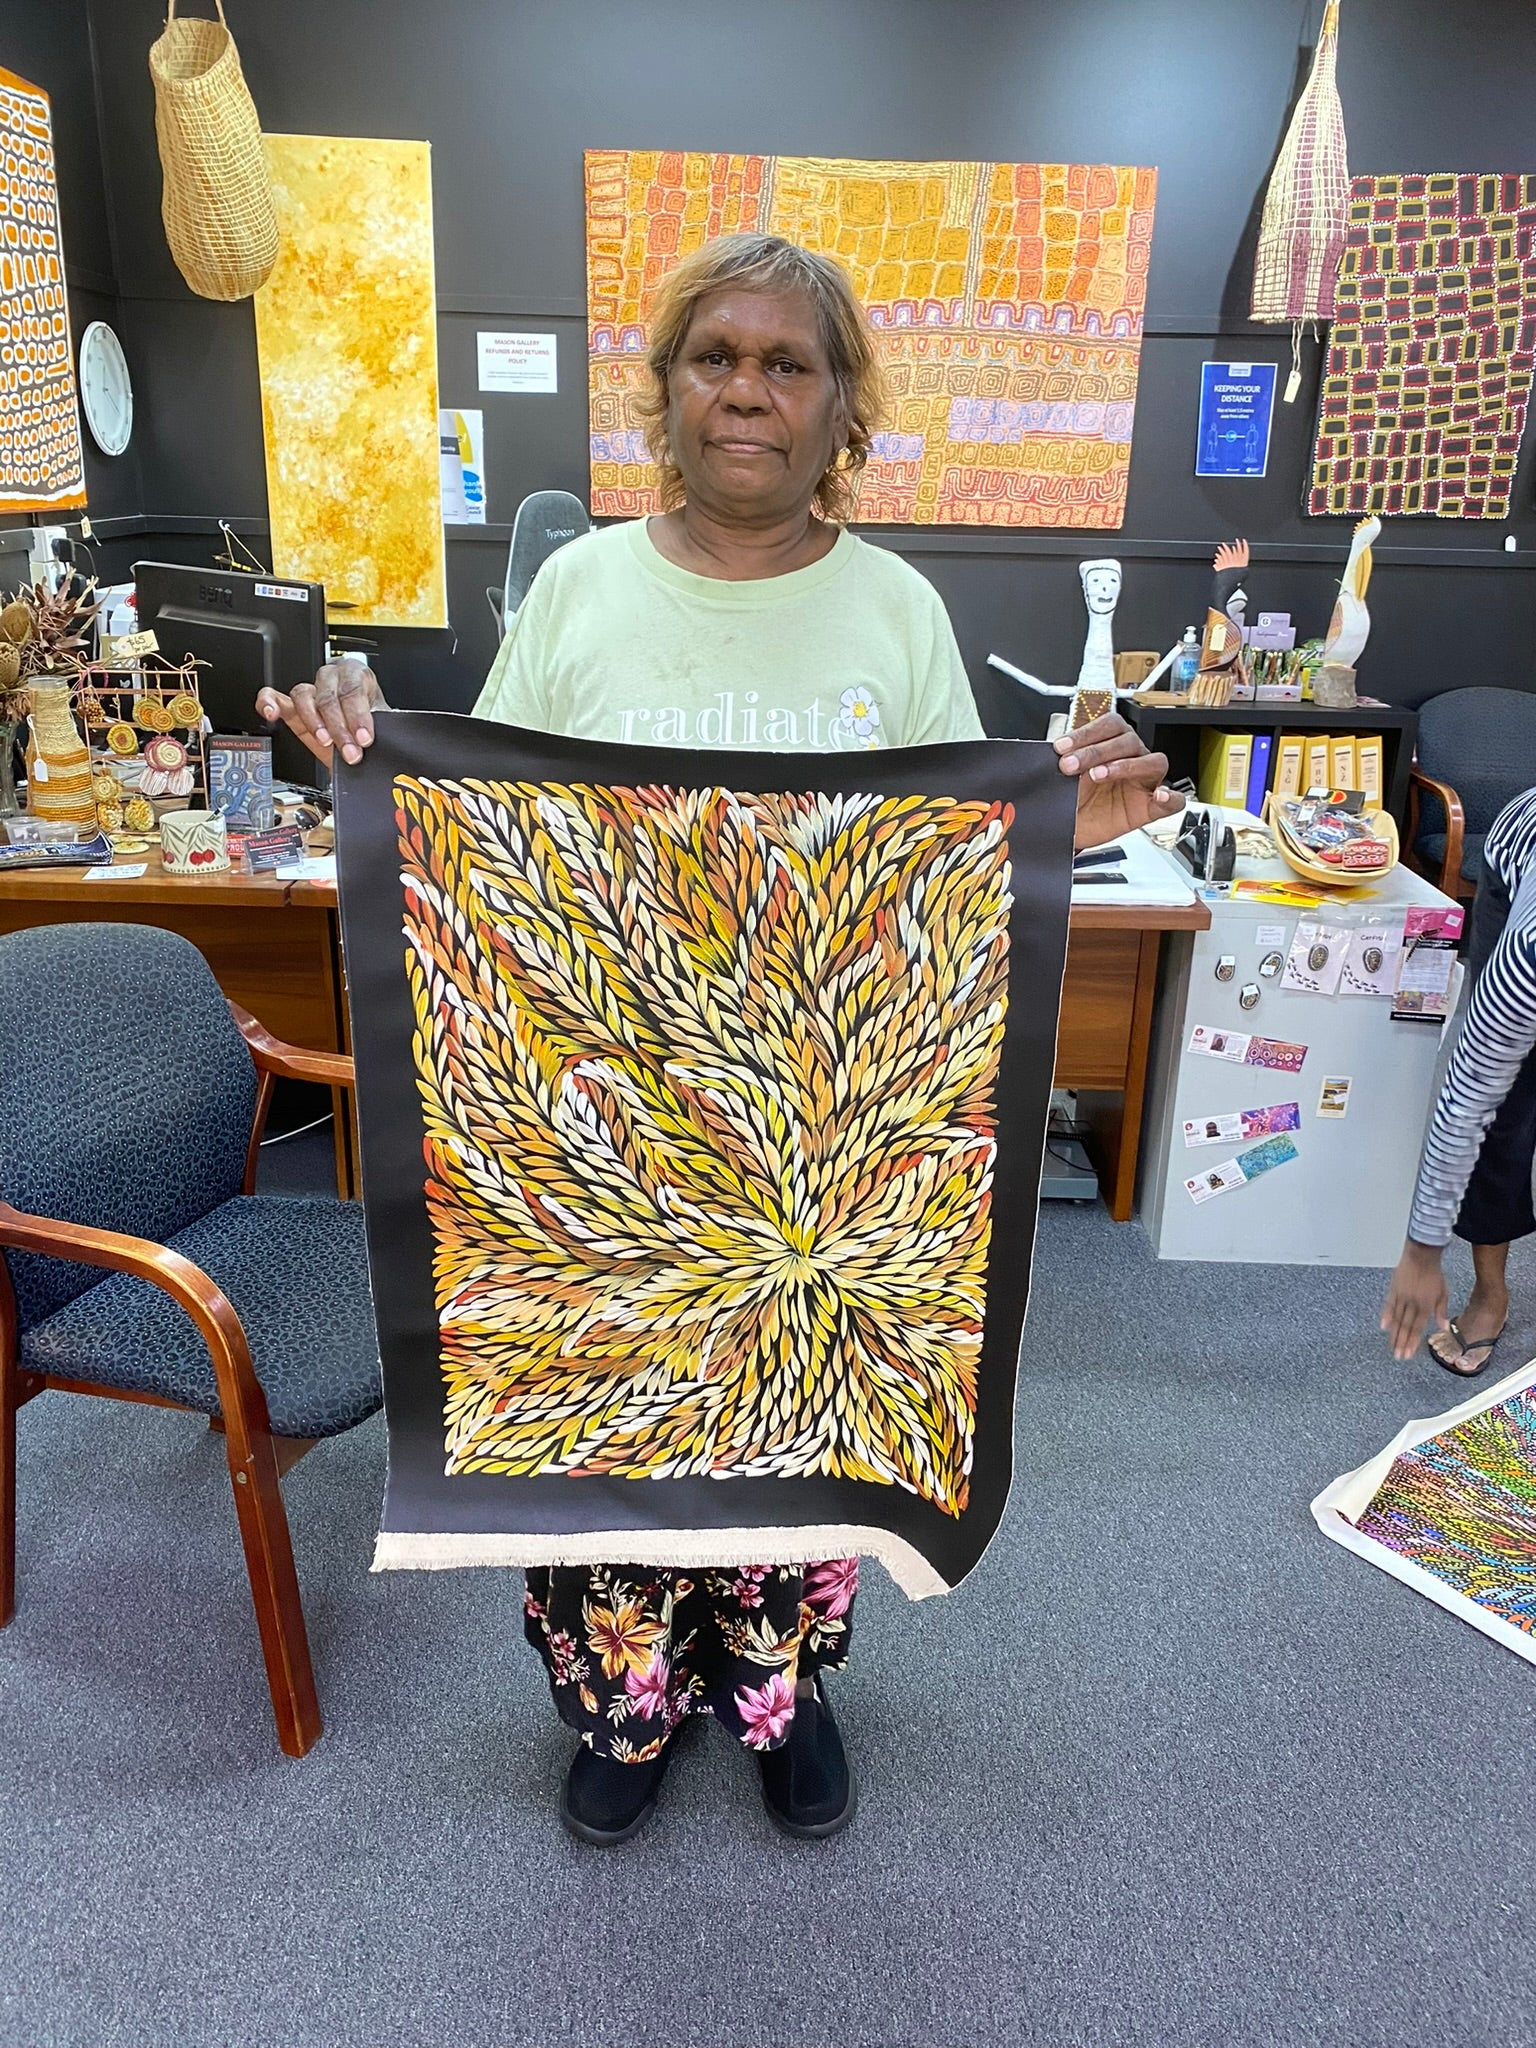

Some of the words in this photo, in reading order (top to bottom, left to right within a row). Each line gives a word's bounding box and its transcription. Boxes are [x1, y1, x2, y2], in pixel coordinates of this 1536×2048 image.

[1213, 384, 1242, 393] KEEPING
[1242, 385, 1261, 393] YOUR
[1221, 395, 1253, 403] DISTANCE
[545, 528, 575, 540] Typhoon
[212, 740, 233, 748] MASON
[248, 839, 269, 848] Mason
[269, 836, 291, 845] Gallery
